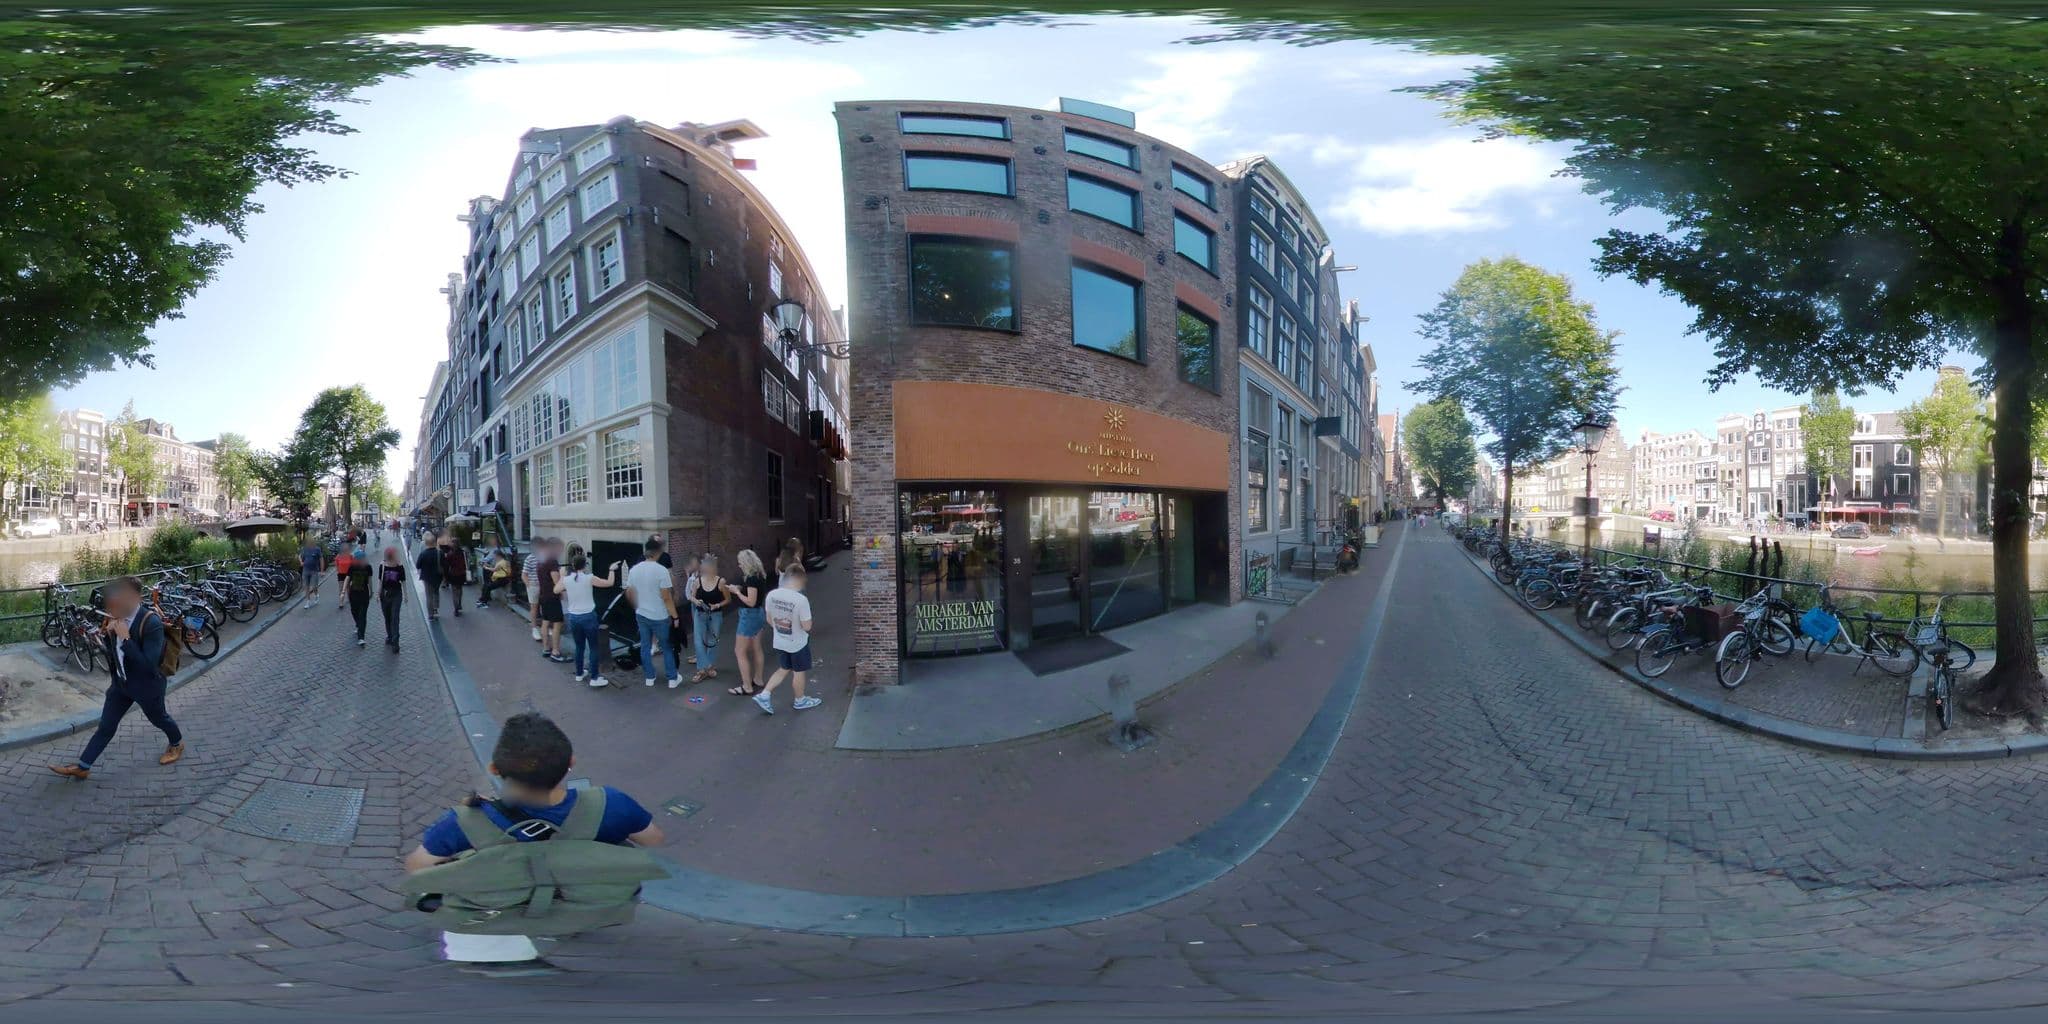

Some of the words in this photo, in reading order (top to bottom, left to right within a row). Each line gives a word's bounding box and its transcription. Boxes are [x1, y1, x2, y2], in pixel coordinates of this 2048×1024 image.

[1131, 448, 1155, 461] Heer
[1087, 463, 1104, 477] op
[1106, 460, 1141, 475] Solder
[916, 603, 970, 619] MIRAKEL
[970, 600, 994, 615] VAN
[916, 613, 994, 632] AMSTERDAM
